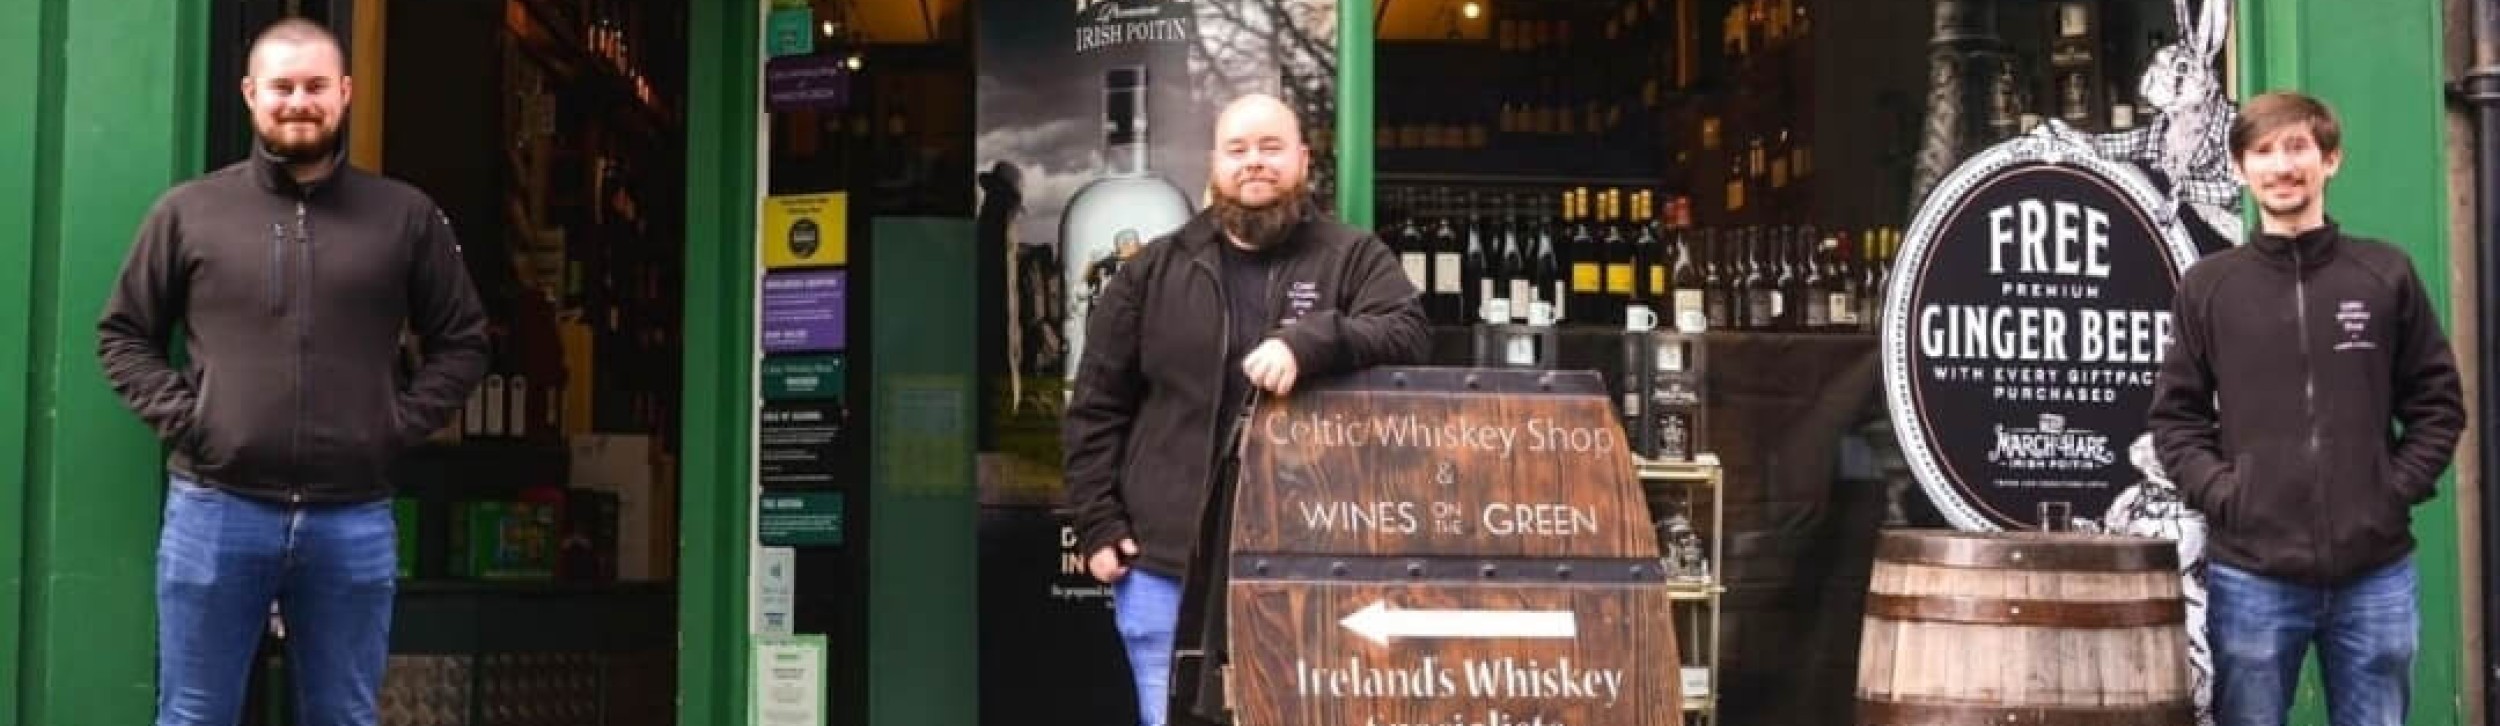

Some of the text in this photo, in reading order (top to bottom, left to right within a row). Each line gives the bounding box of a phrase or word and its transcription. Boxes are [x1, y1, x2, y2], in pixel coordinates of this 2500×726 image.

[1076, 24, 1122, 52] IRISH
[1988, 198, 2111, 278] FREE
[2001, 282, 2100, 298] PREMIUM
[1920, 304, 2068, 360] GINGER
[1933, 366, 2160, 386] WITH EVERY GIFTPAC
[1993, 386, 2116, 403] PURCHASED
[1265, 411, 1615, 459] Celtic Whiskey Shop
[1435, 462, 1454, 484] &
[1300, 501, 1418, 535] WINES
[1434, 501, 1462, 518] ON
[1483, 502, 1598, 535] GREEN
[1463, 656, 1622, 709] Whiskey
